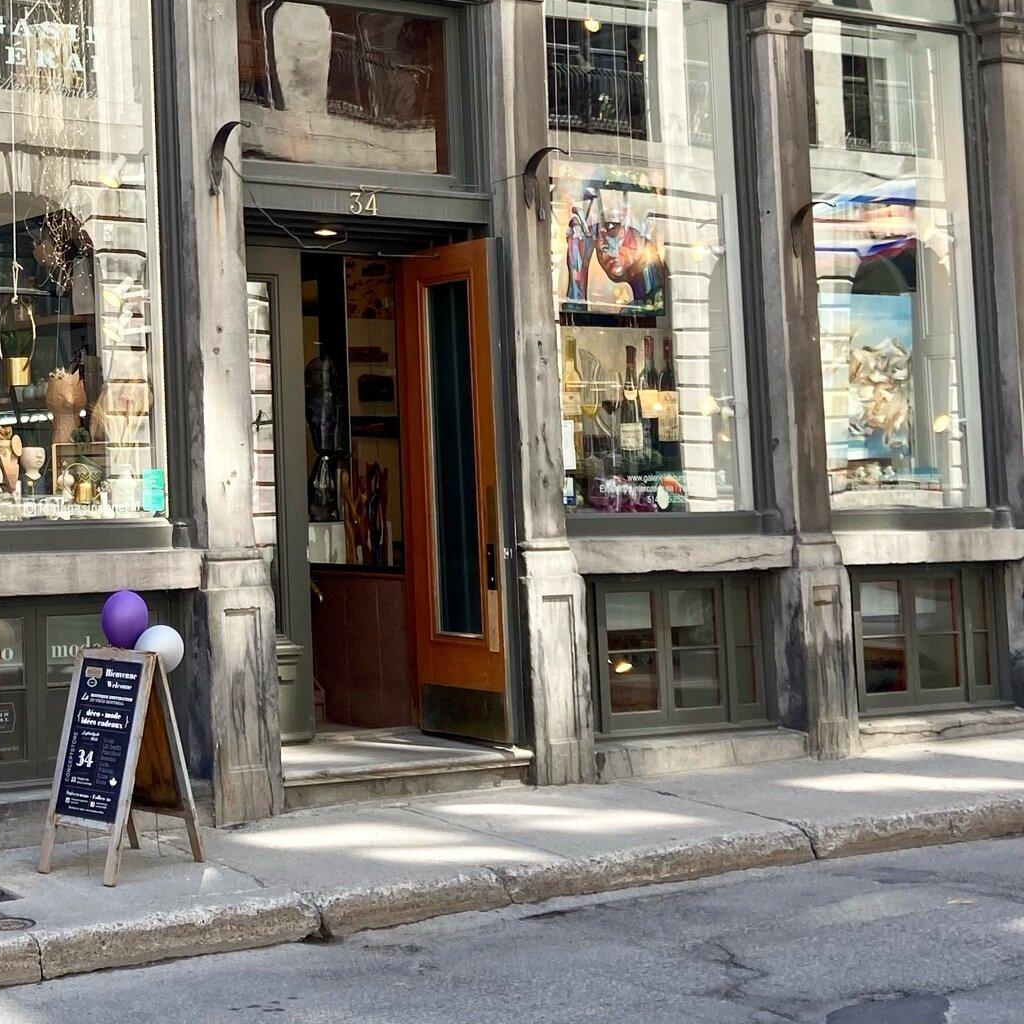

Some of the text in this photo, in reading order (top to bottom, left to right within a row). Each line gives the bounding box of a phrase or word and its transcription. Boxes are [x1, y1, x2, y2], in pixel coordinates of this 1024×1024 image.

[349, 192, 378, 216] 34
[51, 636, 100, 658] mod
[86, 708, 121, 720] déco mode
[97, 720, 123, 729] cadeaux
[75, 749, 94, 768] 34
